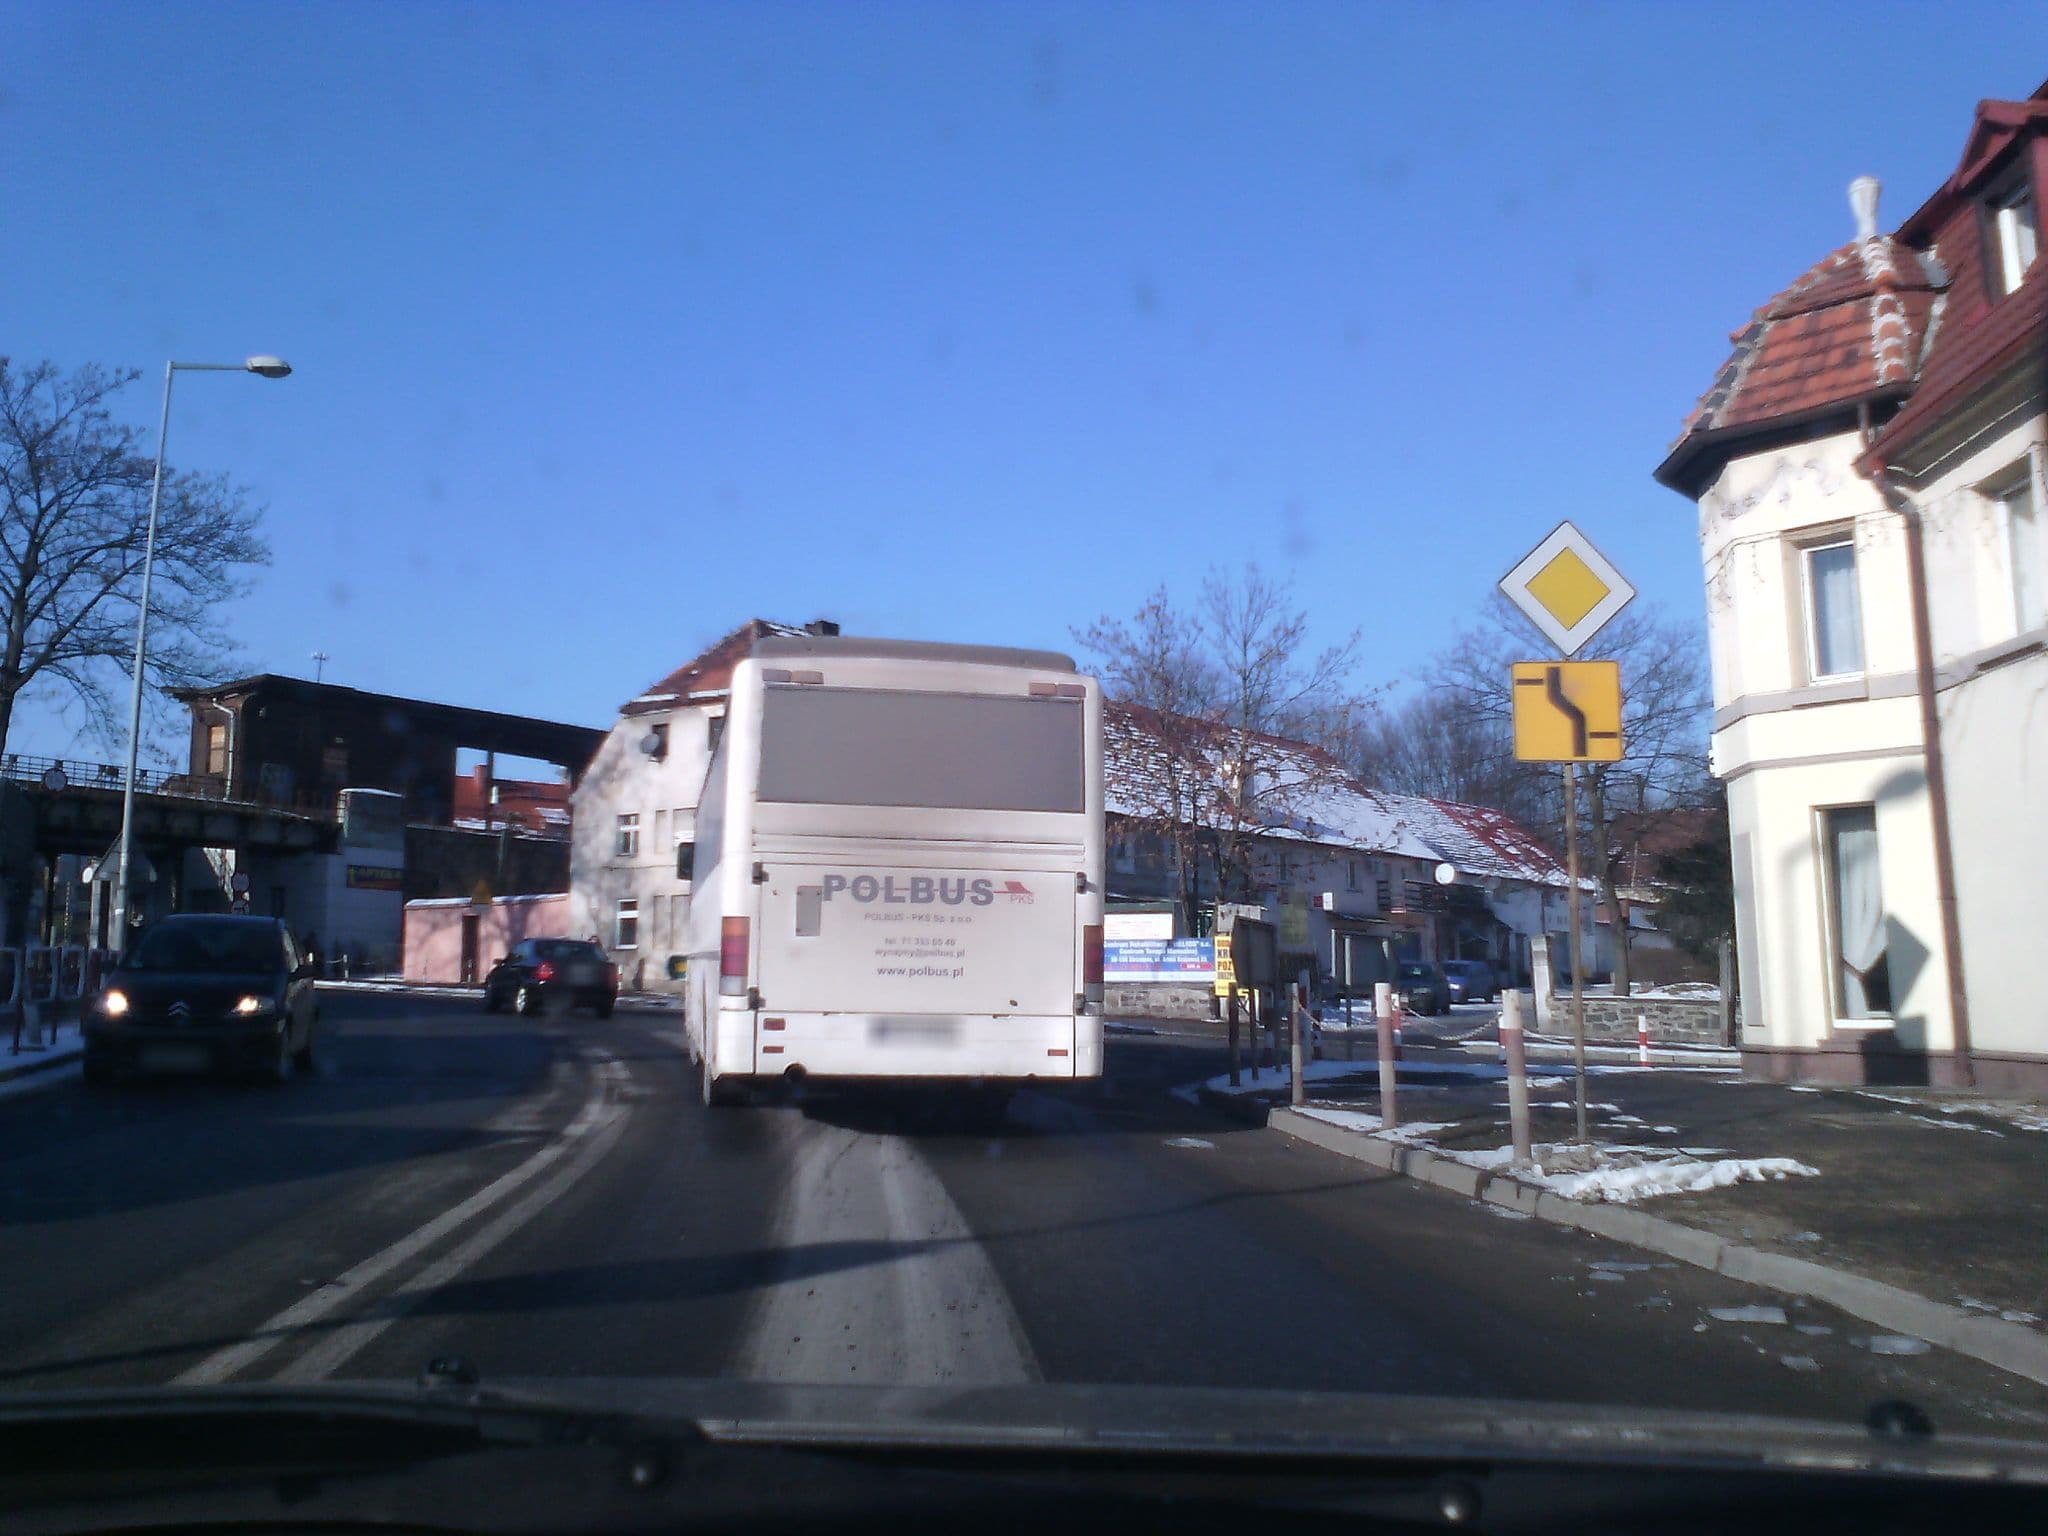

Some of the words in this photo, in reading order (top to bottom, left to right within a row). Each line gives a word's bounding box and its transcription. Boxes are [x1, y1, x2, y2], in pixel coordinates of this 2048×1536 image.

[824, 874, 994, 906] POLBUS
[1009, 895, 1034, 905] PKS
[864, 911, 904, 921] POLBUS
[911, 912, 931, 922] PKS
[877, 966, 964, 978] www.polbus.pl
